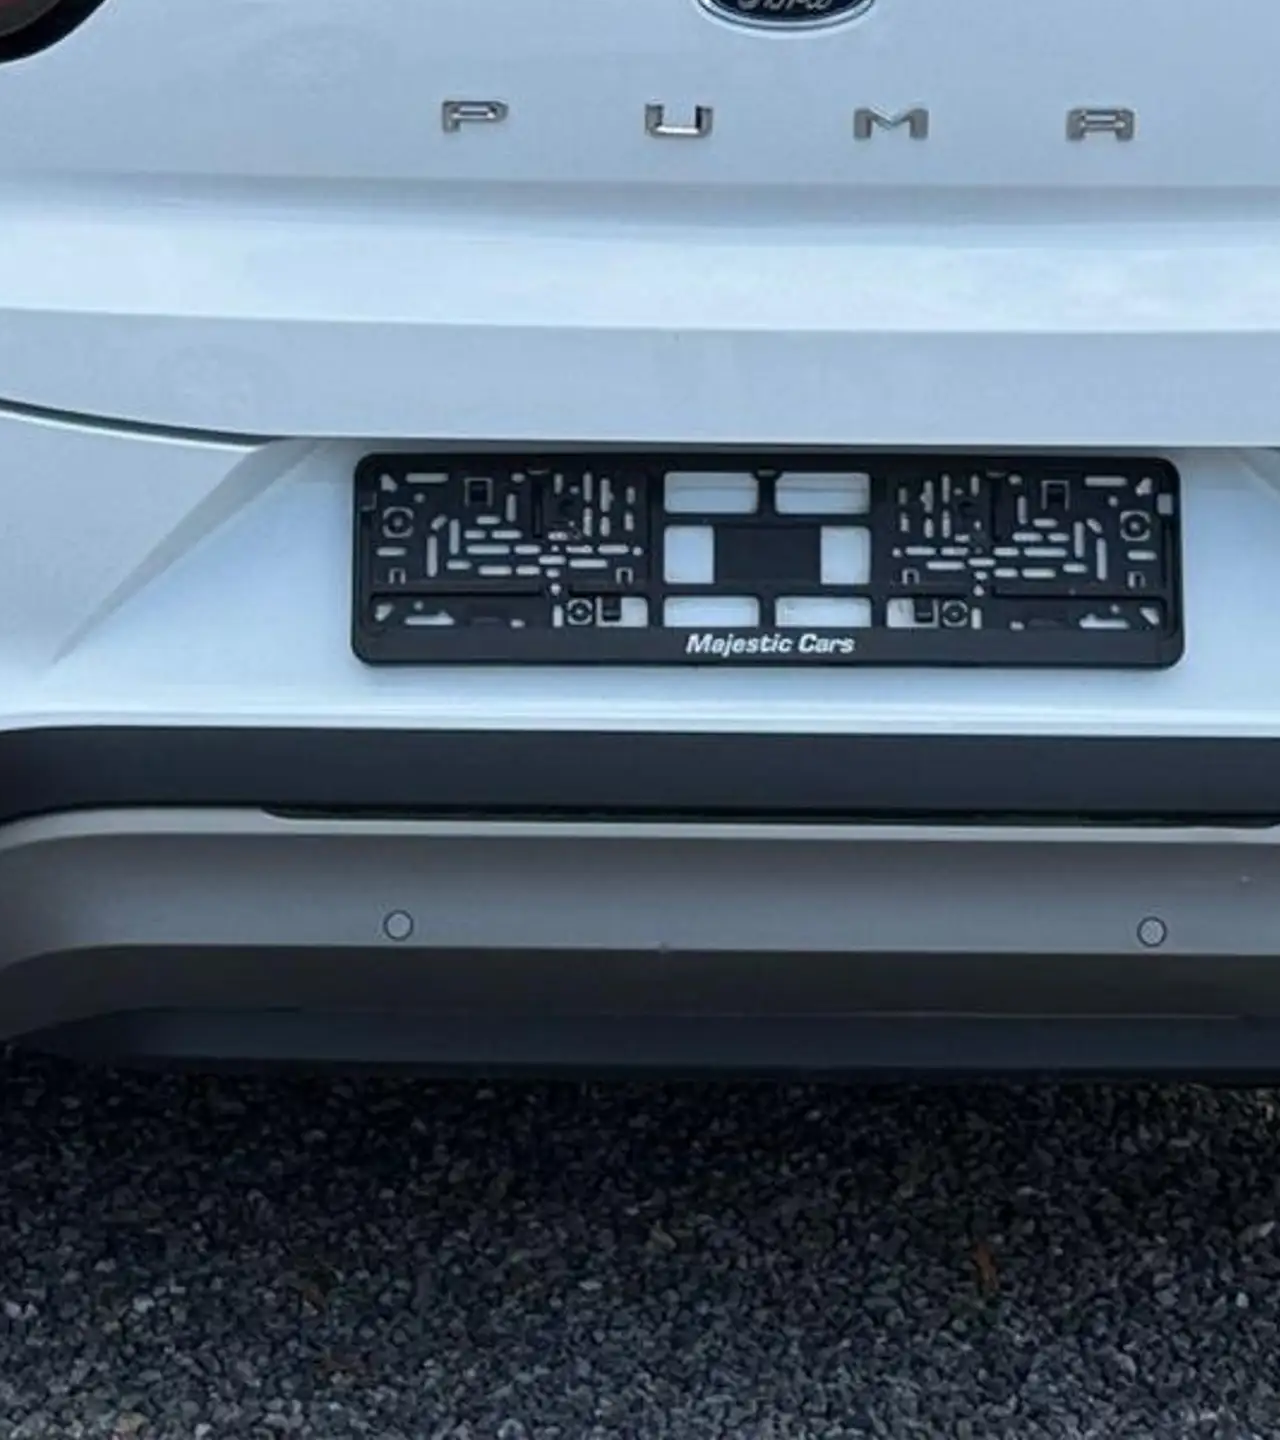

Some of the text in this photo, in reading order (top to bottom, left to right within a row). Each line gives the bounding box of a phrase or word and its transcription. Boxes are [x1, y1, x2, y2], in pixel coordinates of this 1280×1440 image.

[440, 99, 1137, 143] PUMA
[685, 632, 856, 658] Majestic Cars
